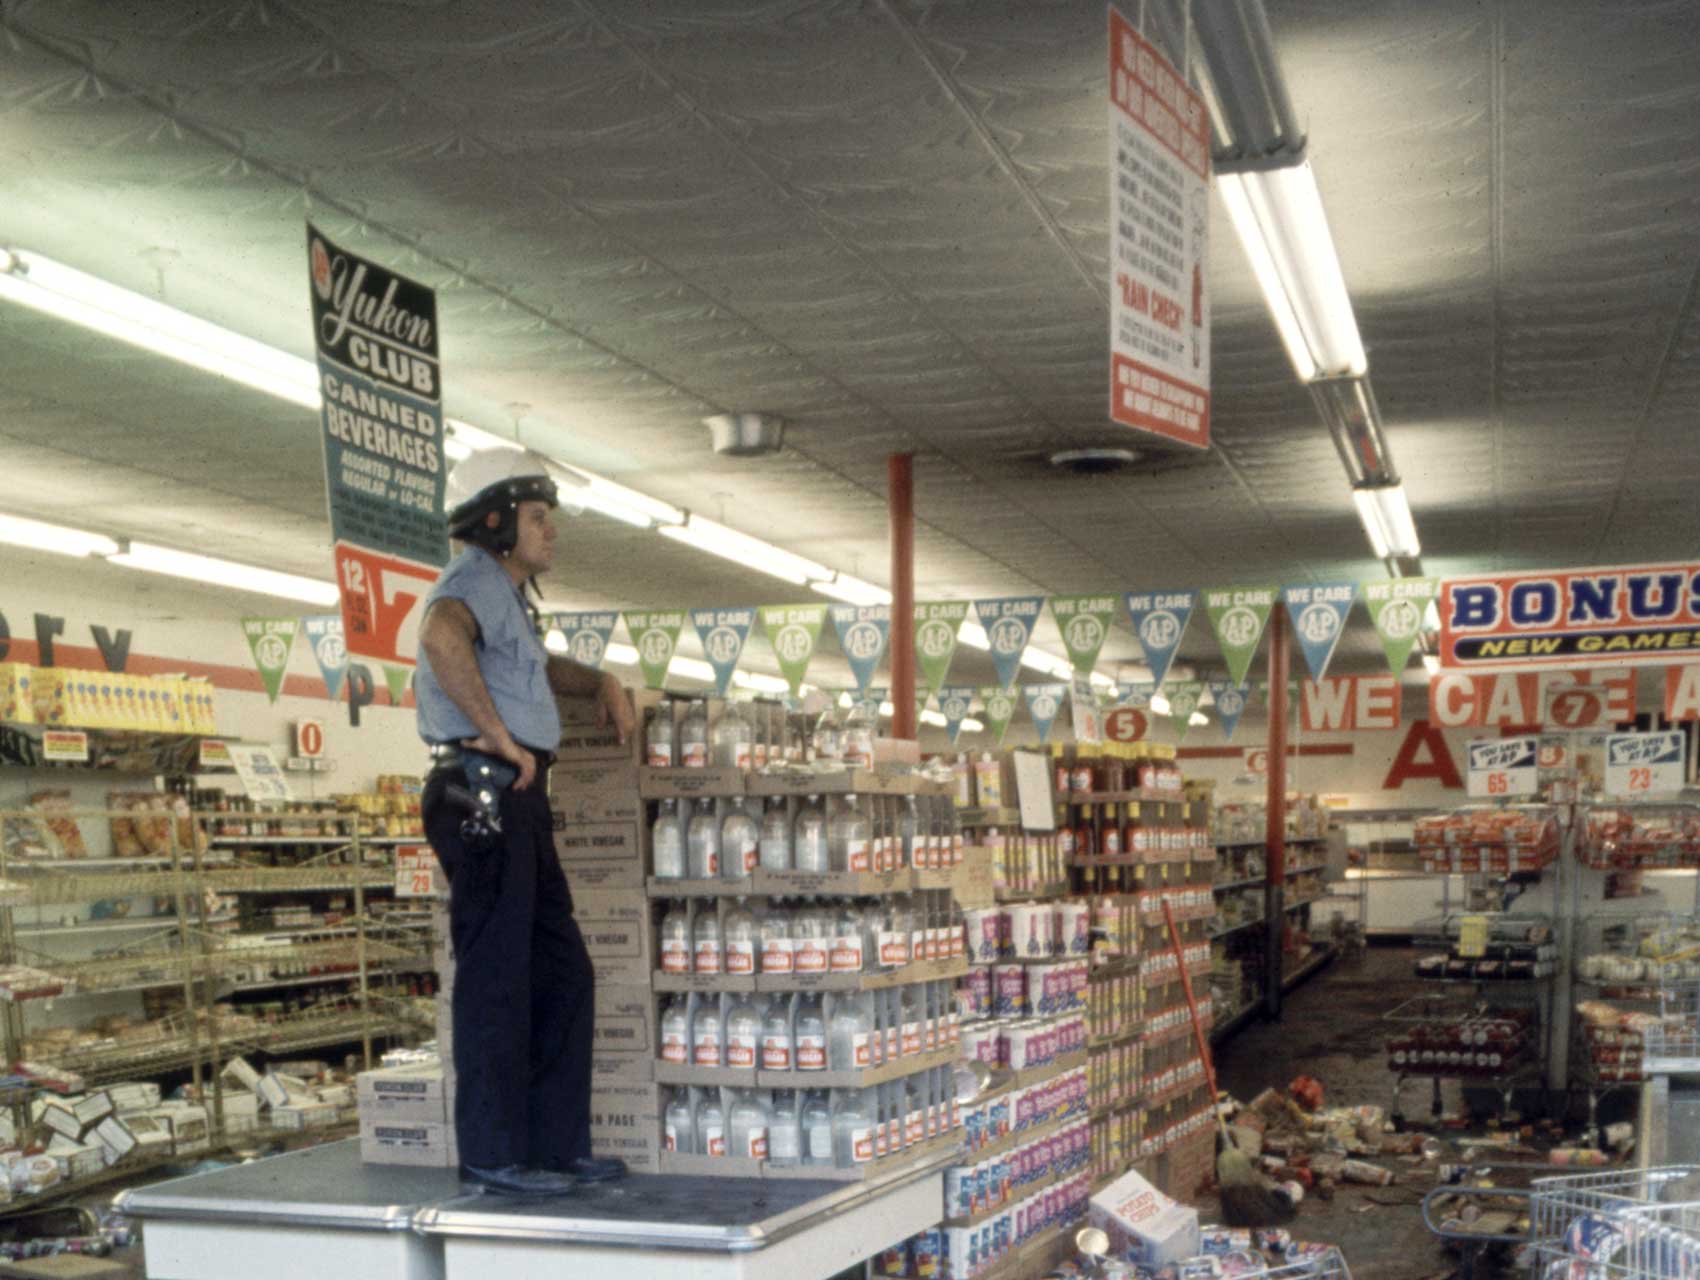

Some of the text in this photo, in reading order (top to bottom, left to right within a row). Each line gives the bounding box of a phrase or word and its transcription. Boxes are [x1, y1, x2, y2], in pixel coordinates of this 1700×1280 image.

[321, 254, 431, 347] Yukon
[348, 335, 433, 392] CLUB
[323, 372, 436, 436] CANNED
[326, 402, 438, 474] BEVERAGES
[343, 558, 365, 594] 12
[1287, 589, 1309, 603] WE
[1367, 585, 1389, 599] WE
[1129, 597, 1150, 610] WE
[1209, 593, 1233, 607] WE
[1451, 573, 1700, 626] BONU
[979, 603, 999, 617] WE
[1055, 600, 1076, 614] WE
[562, 614, 579, 628] WE
[628, 614, 647, 628] WE
[696, 613, 714, 626] WE
[766, 611, 785, 625] WE
[834, 608, 854, 622] WE
[245, 621, 262, 634] WE
[306, 621, 325, 634] WE
[1478, 637, 1563, 656] NEW
[1304, 678, 1397, 729] WE
[1564, 695, 1587, 723] 7
[1115, 713, 1135, 740] 5
[607, 1113, 635, 1127] PAGE
